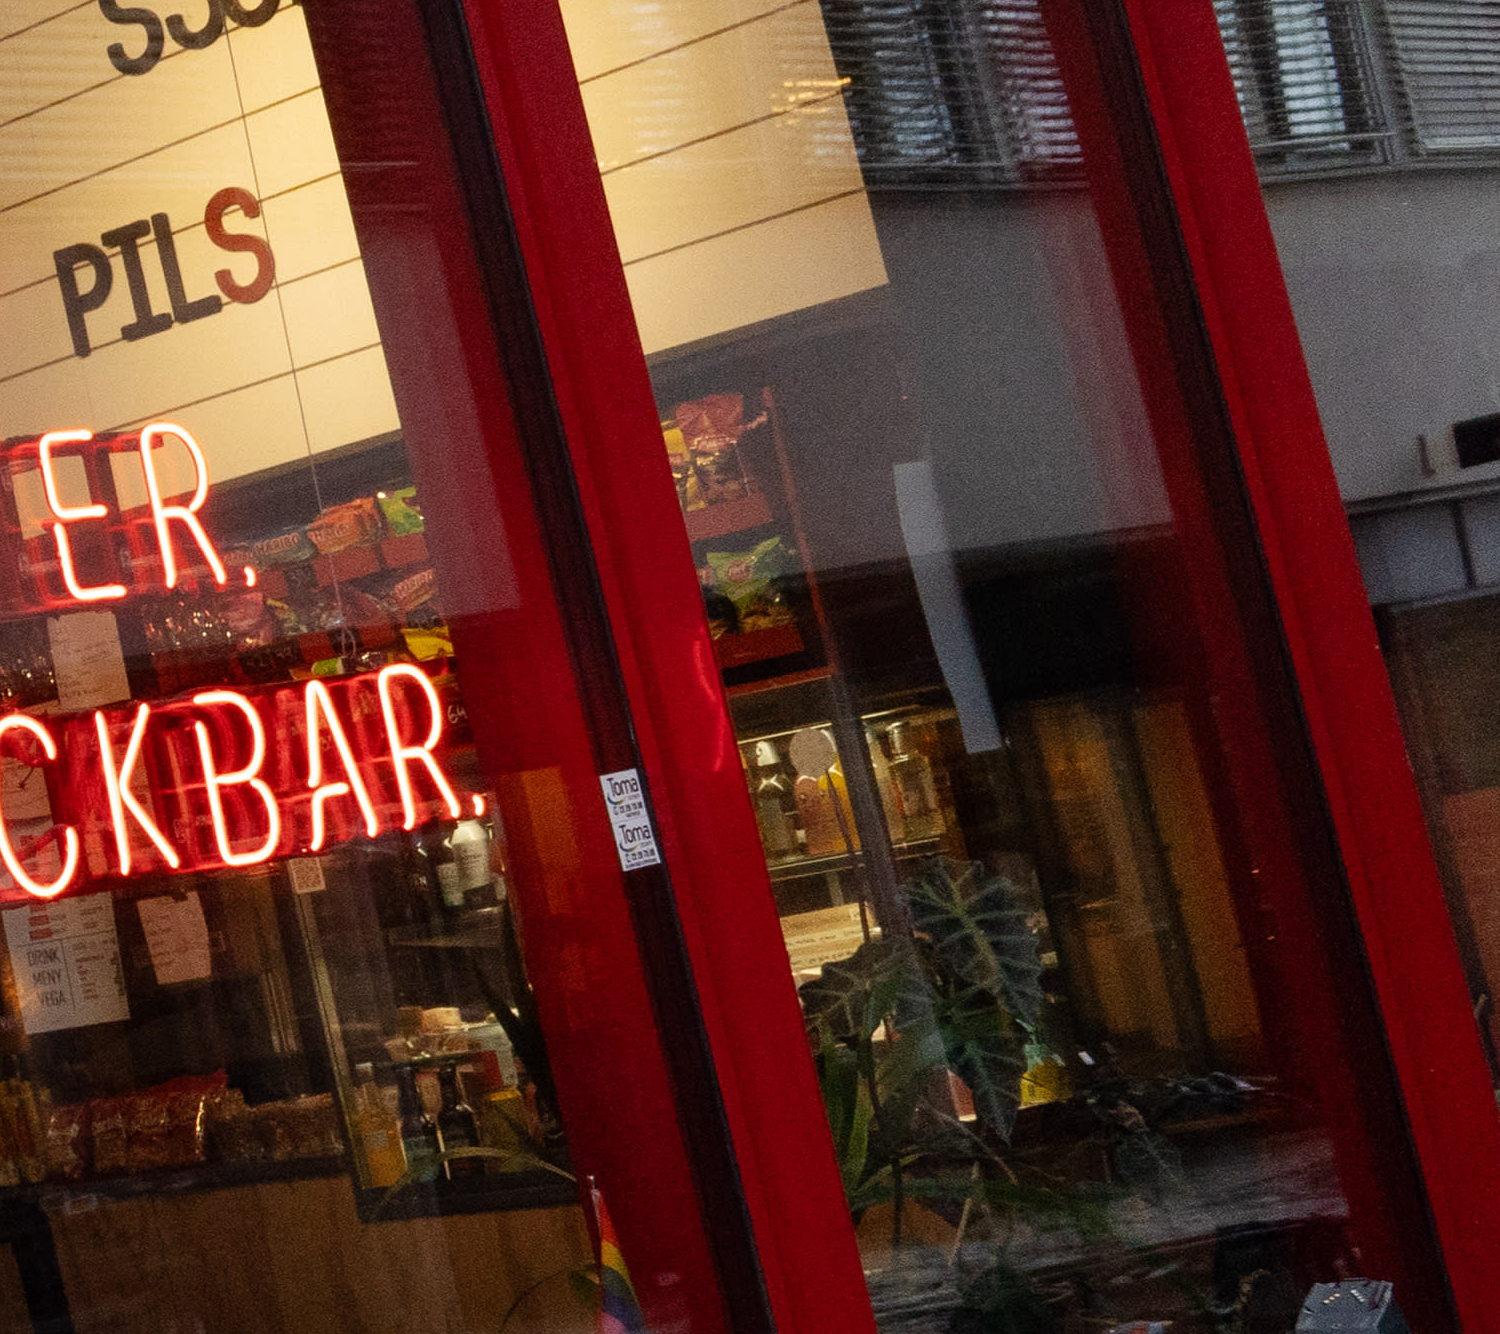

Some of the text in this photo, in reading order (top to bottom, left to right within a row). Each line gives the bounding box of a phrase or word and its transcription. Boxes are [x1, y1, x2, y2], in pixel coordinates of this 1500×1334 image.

[52, 186, 277, 358] PILS
[606, 777, 639, 797] Toma
[618, 823, 651, 845] Toma
[26, 948, 60, 968] DRINK
